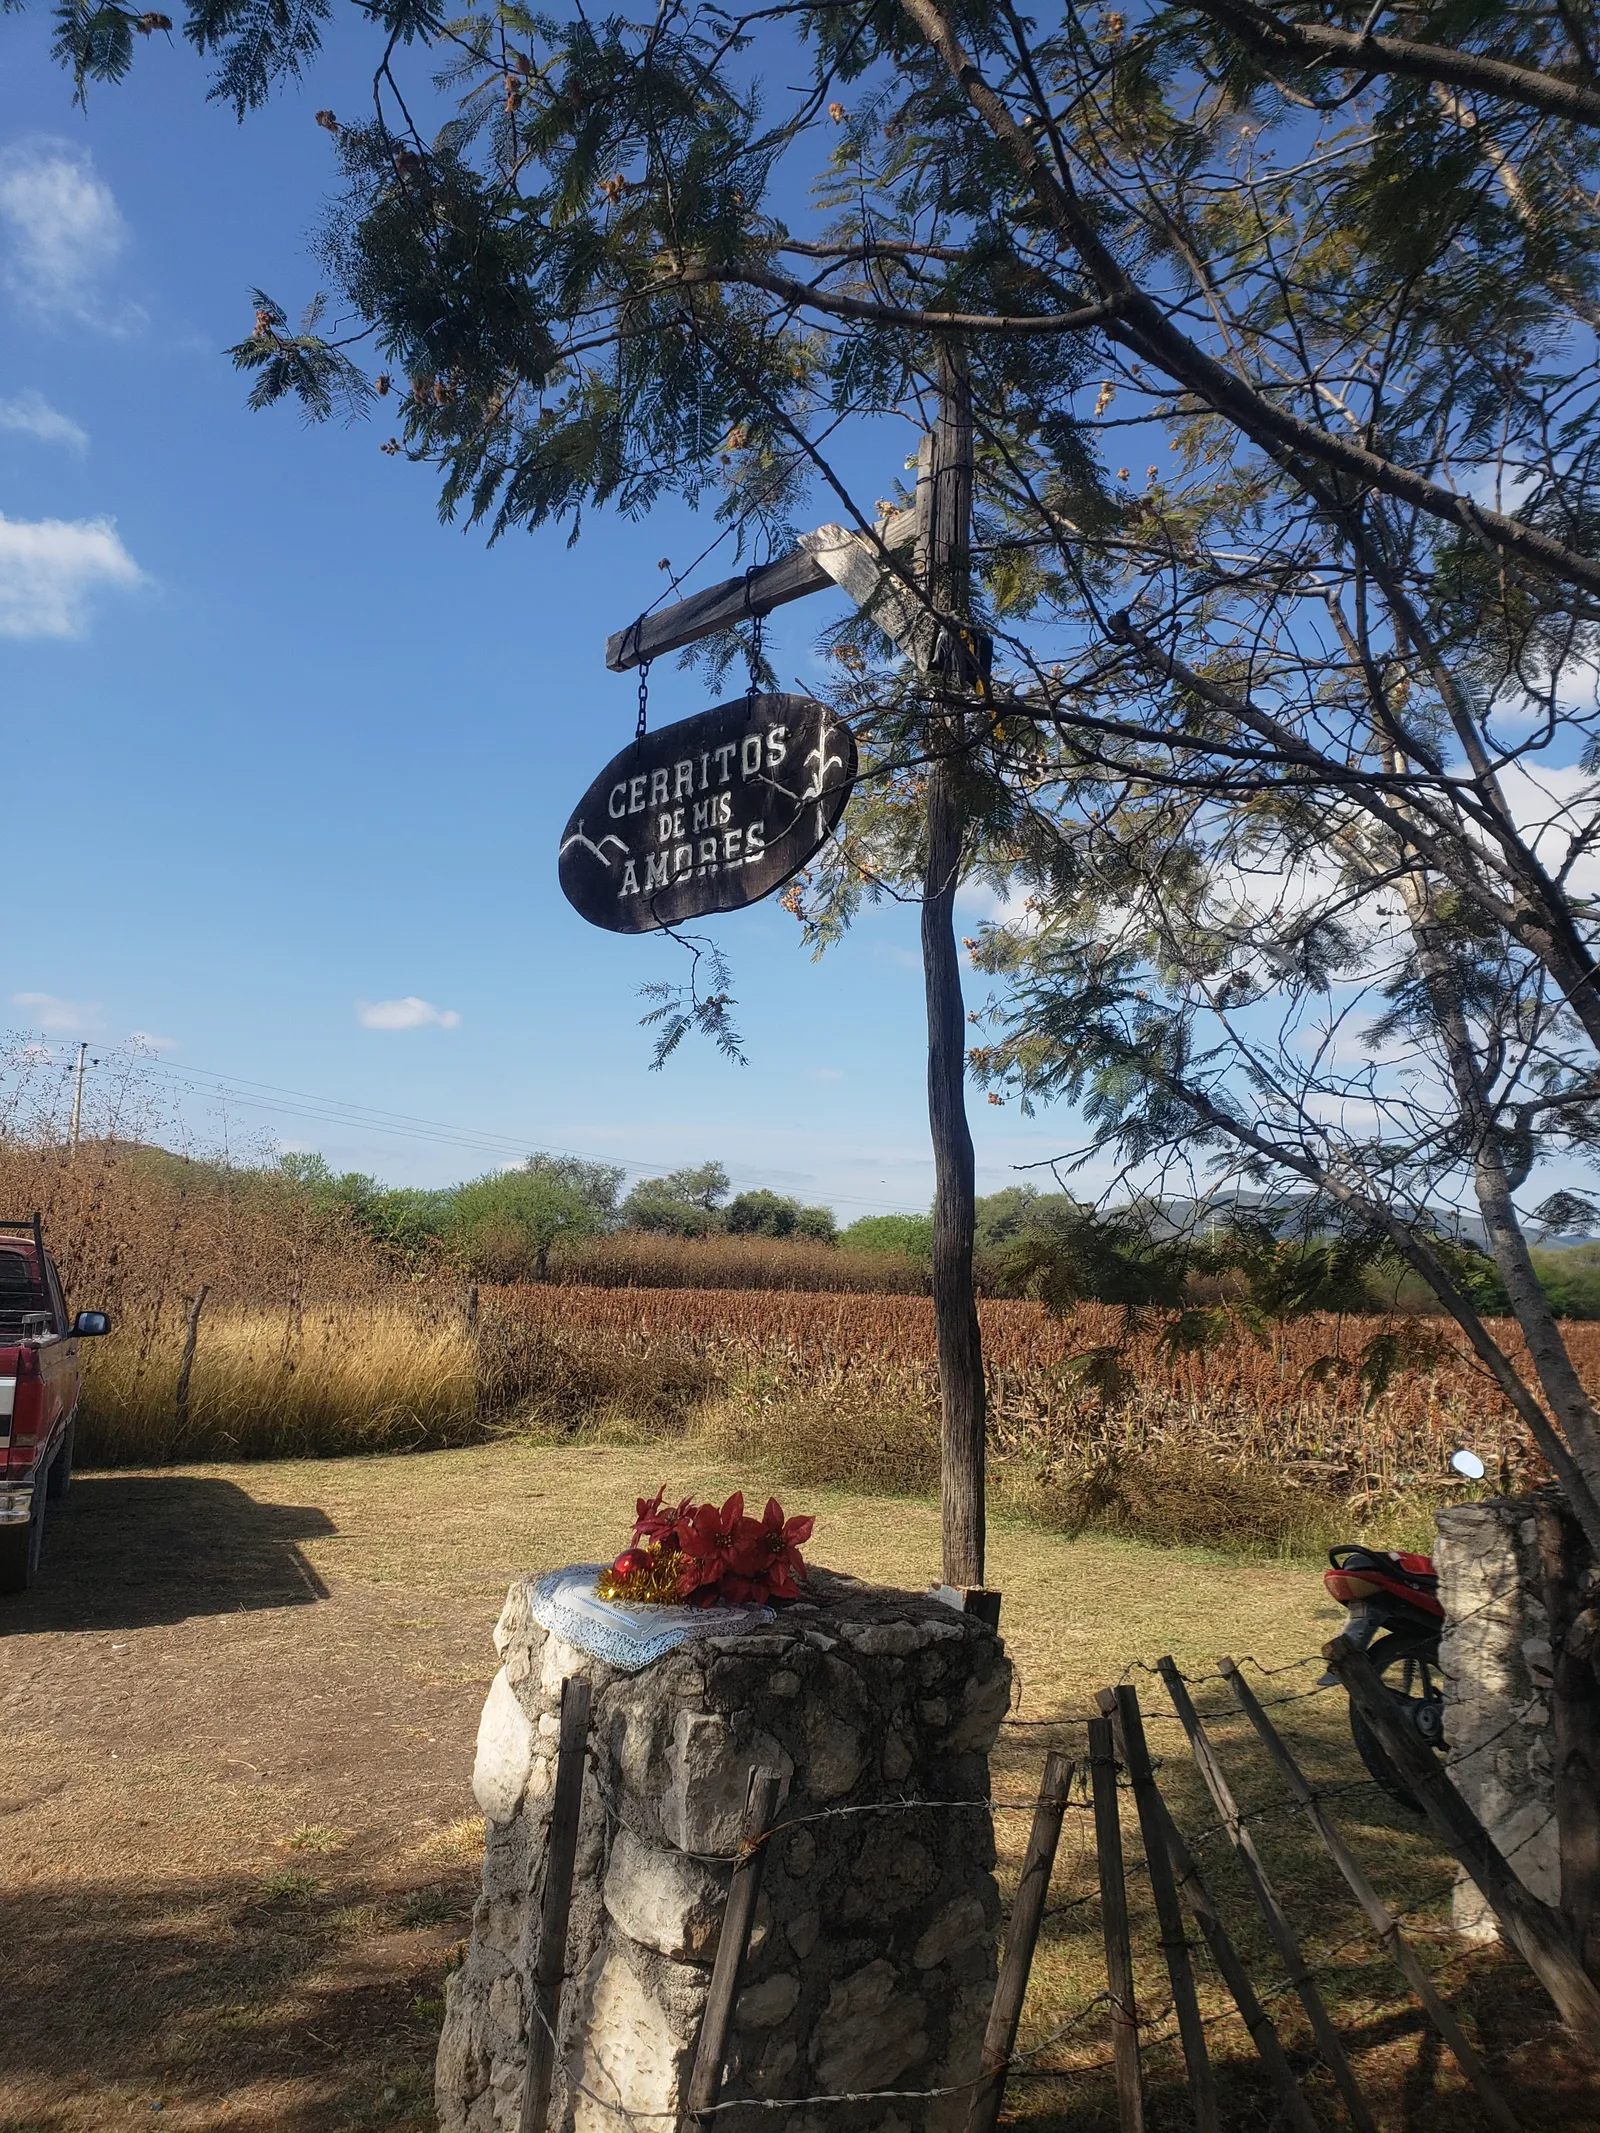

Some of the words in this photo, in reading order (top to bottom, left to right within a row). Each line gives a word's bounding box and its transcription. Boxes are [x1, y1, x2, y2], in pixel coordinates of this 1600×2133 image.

[608, 725, 787, 819] CERRITOS
[659, 808, 686, 842] DE
[693, 791, 732, 834] MIS
[618, 821, 766, 897] AMORES
